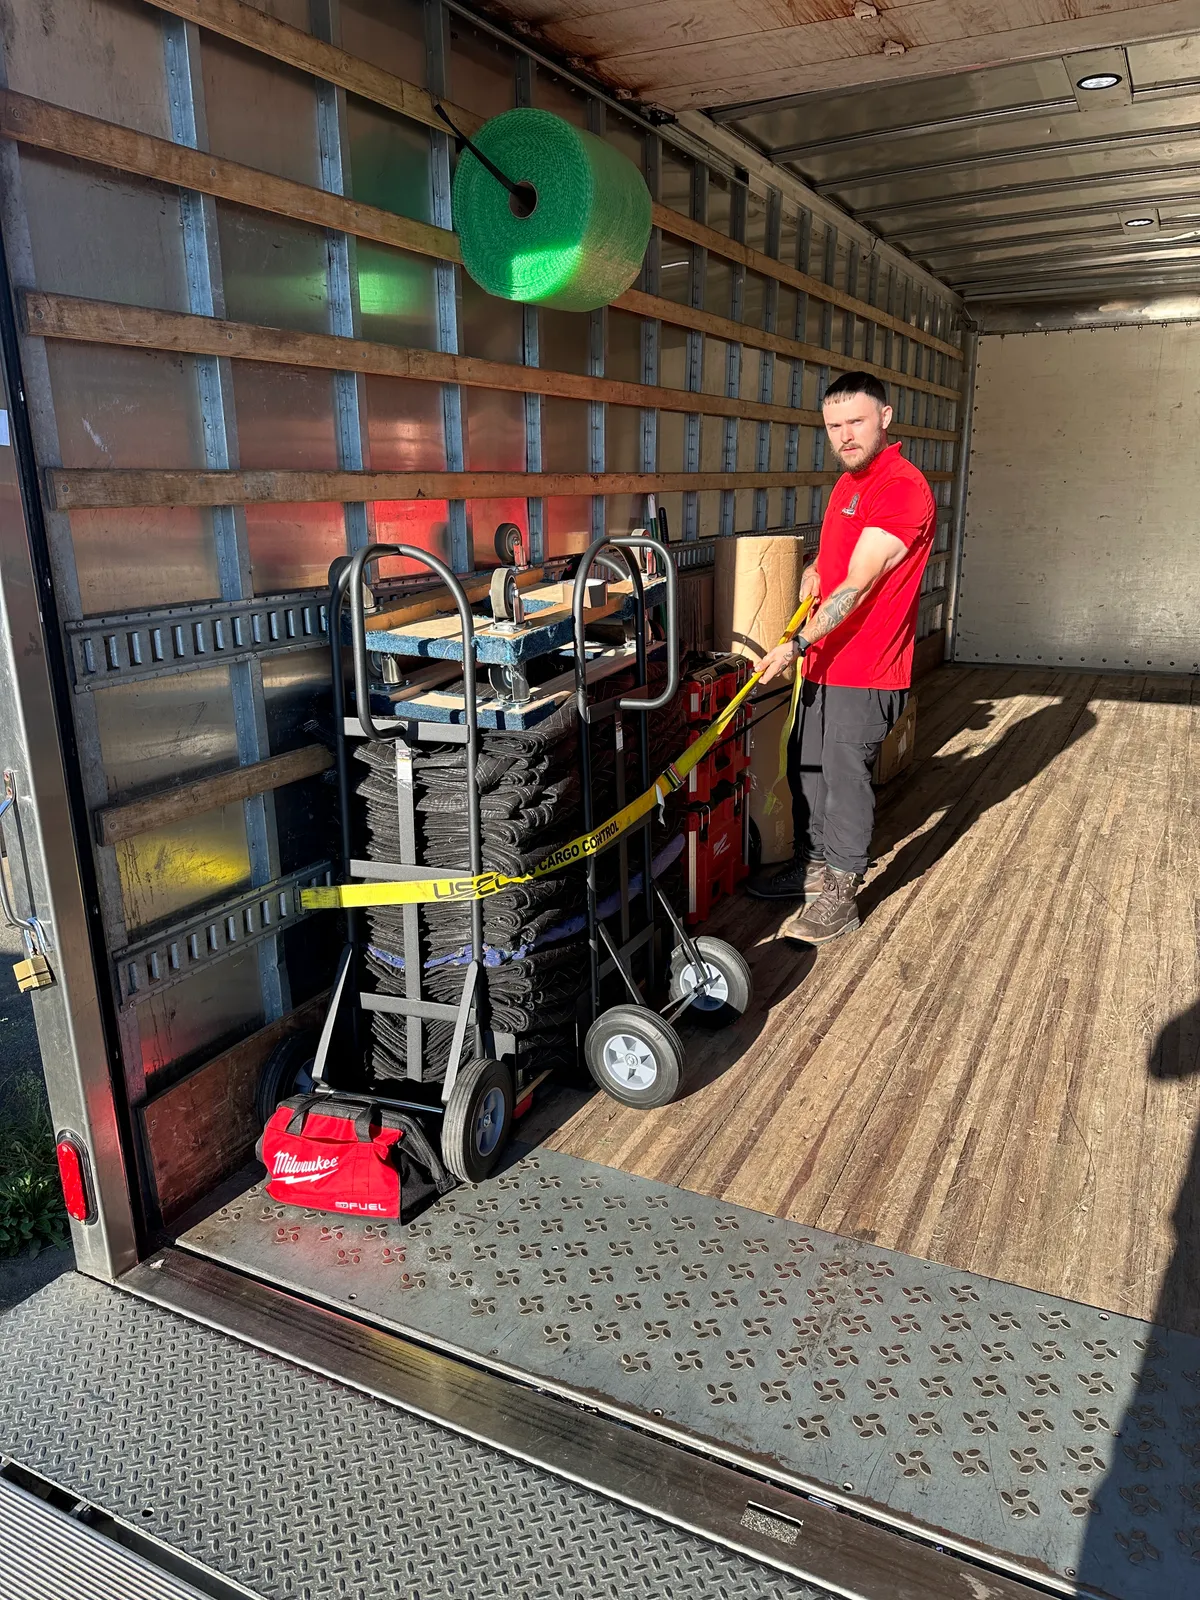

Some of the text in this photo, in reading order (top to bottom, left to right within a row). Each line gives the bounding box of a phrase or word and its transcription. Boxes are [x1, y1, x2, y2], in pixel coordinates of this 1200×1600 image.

[538, 844, 580, 871] CARGO
[581, 820, 619, 853] CONTROL
[273, 1150, 338, 1175] Milwaukee
[349, 1202, 387, 1212] FUEL
